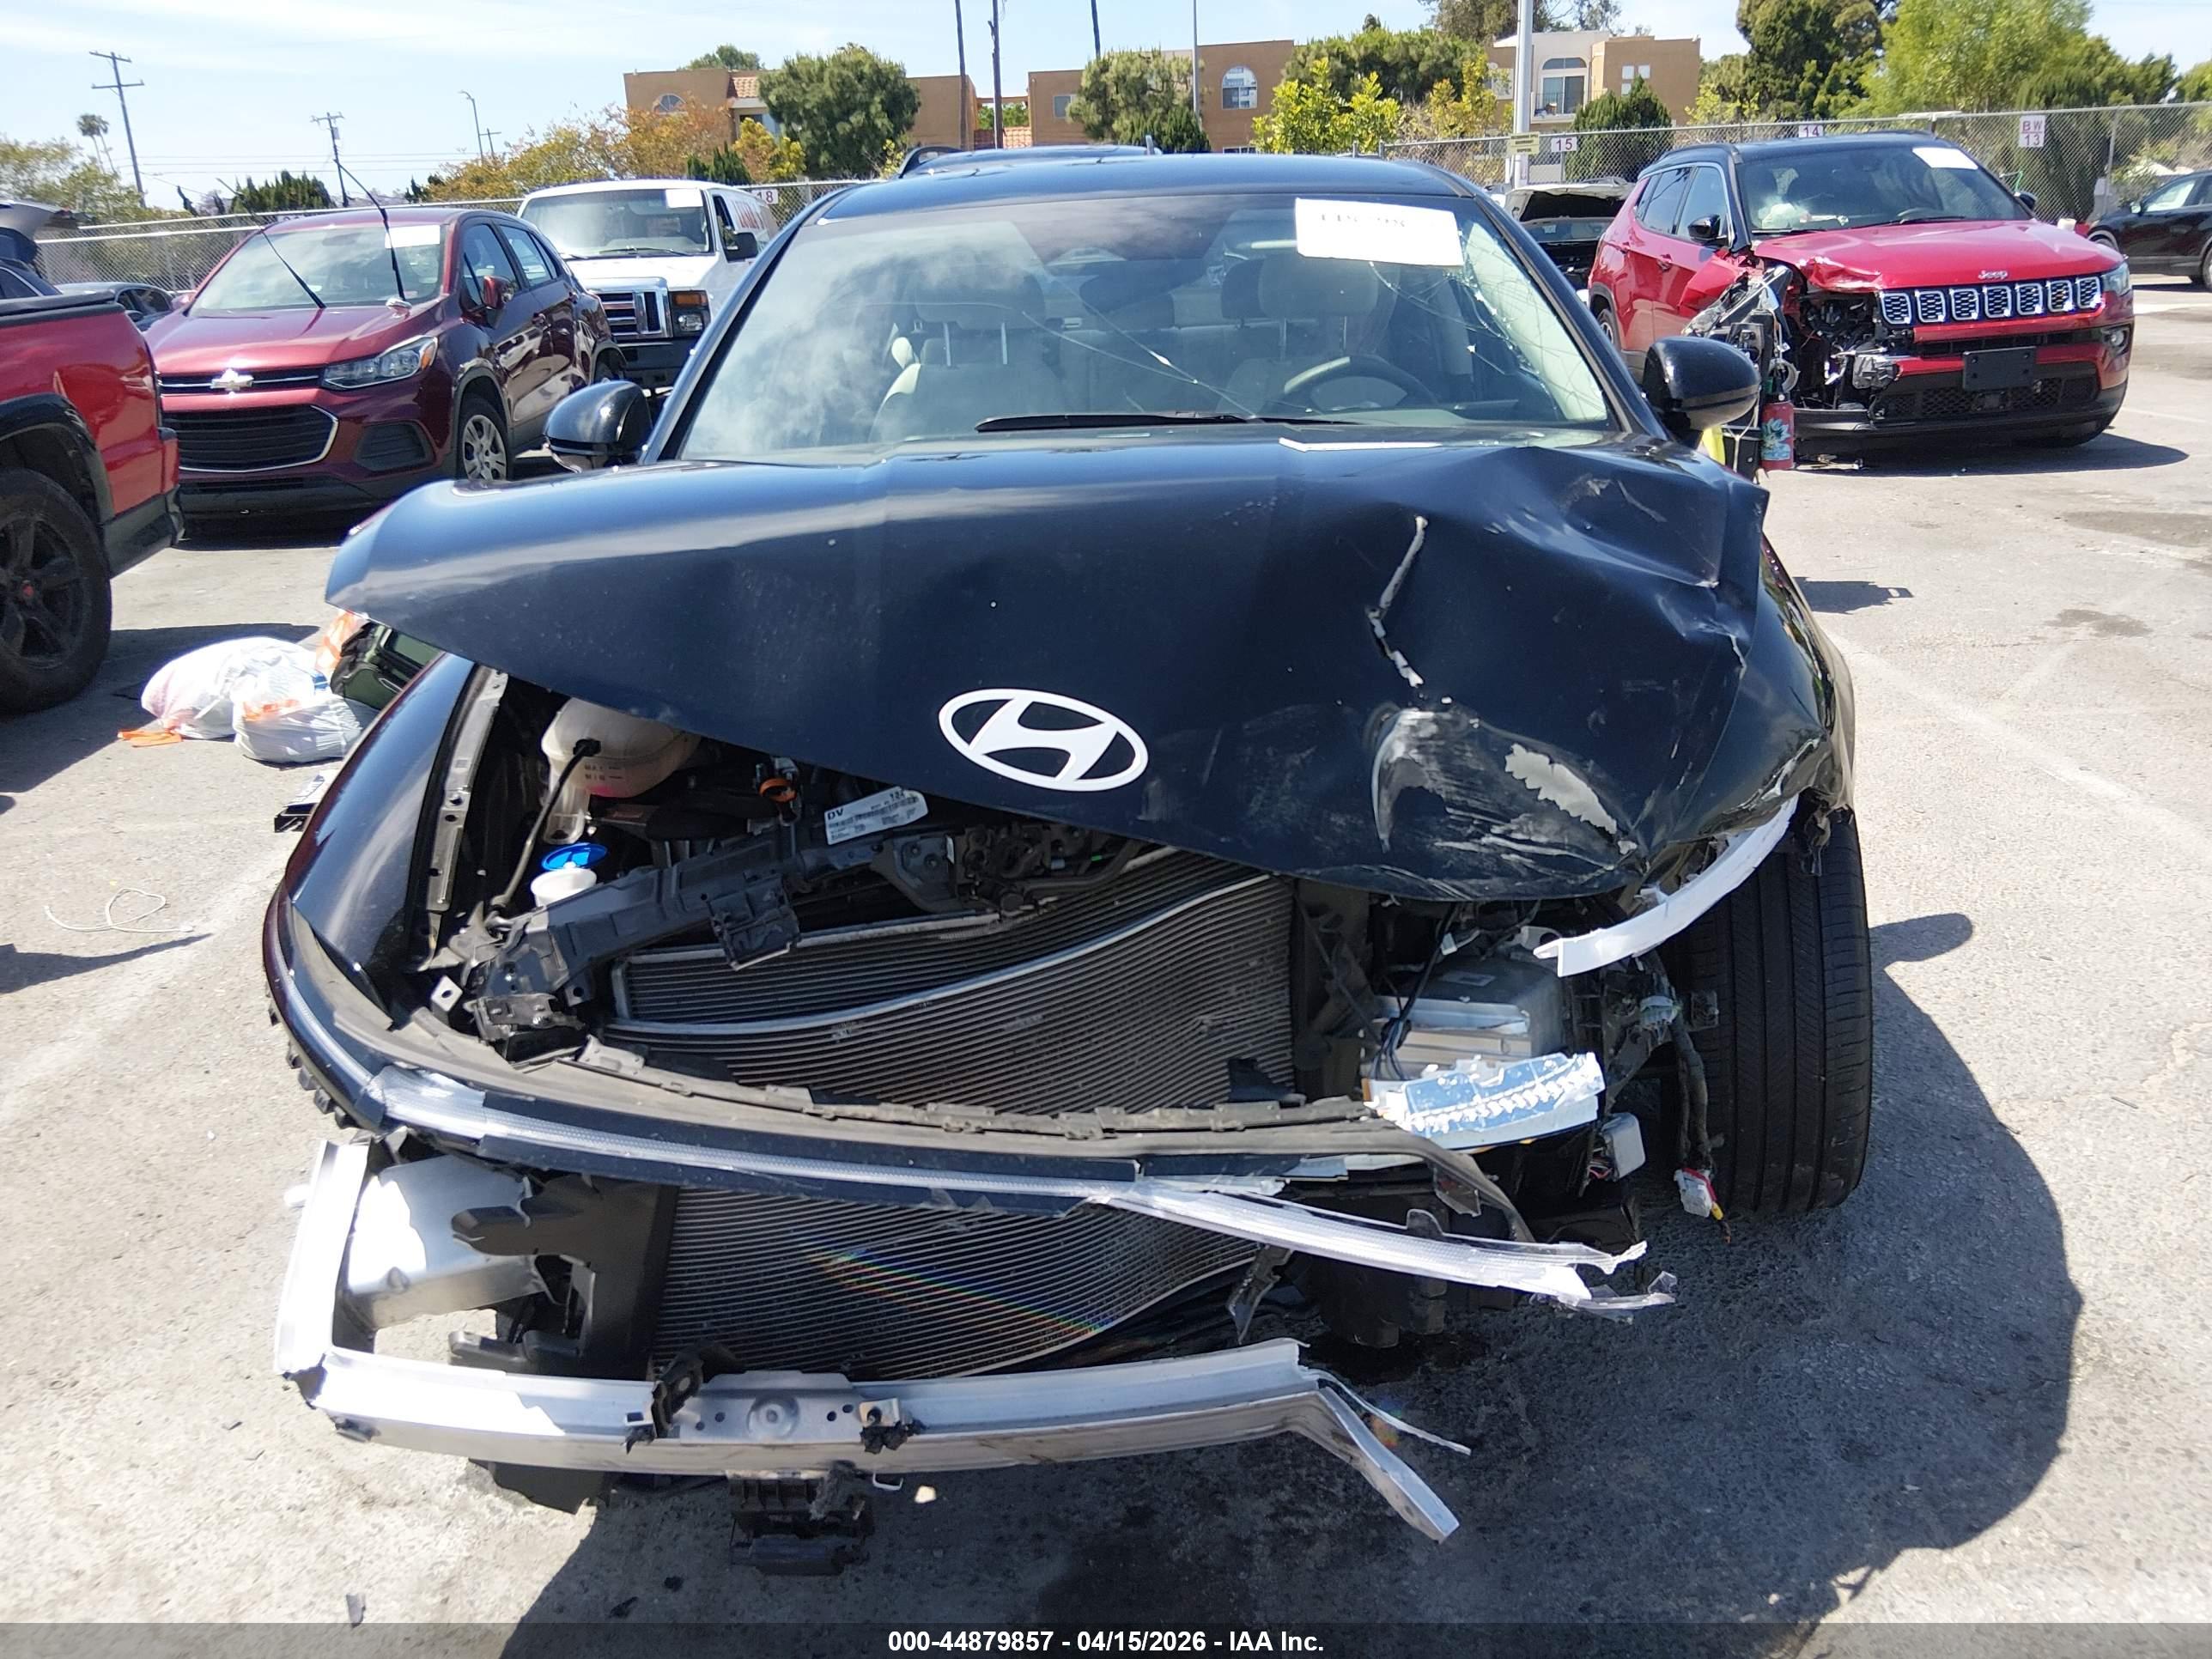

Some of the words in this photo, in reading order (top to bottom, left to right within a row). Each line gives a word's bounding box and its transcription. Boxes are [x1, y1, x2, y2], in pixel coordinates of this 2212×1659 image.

[1803, 125, 1820, 137] 14
[1555, 137, 1573, 151] 15
[2025, 133, 2040, 146] 13
[757, 191, 774, 204] 18
[1978, 270, 2008, 280] Jeep
[827, 808, 844, 820] DV
